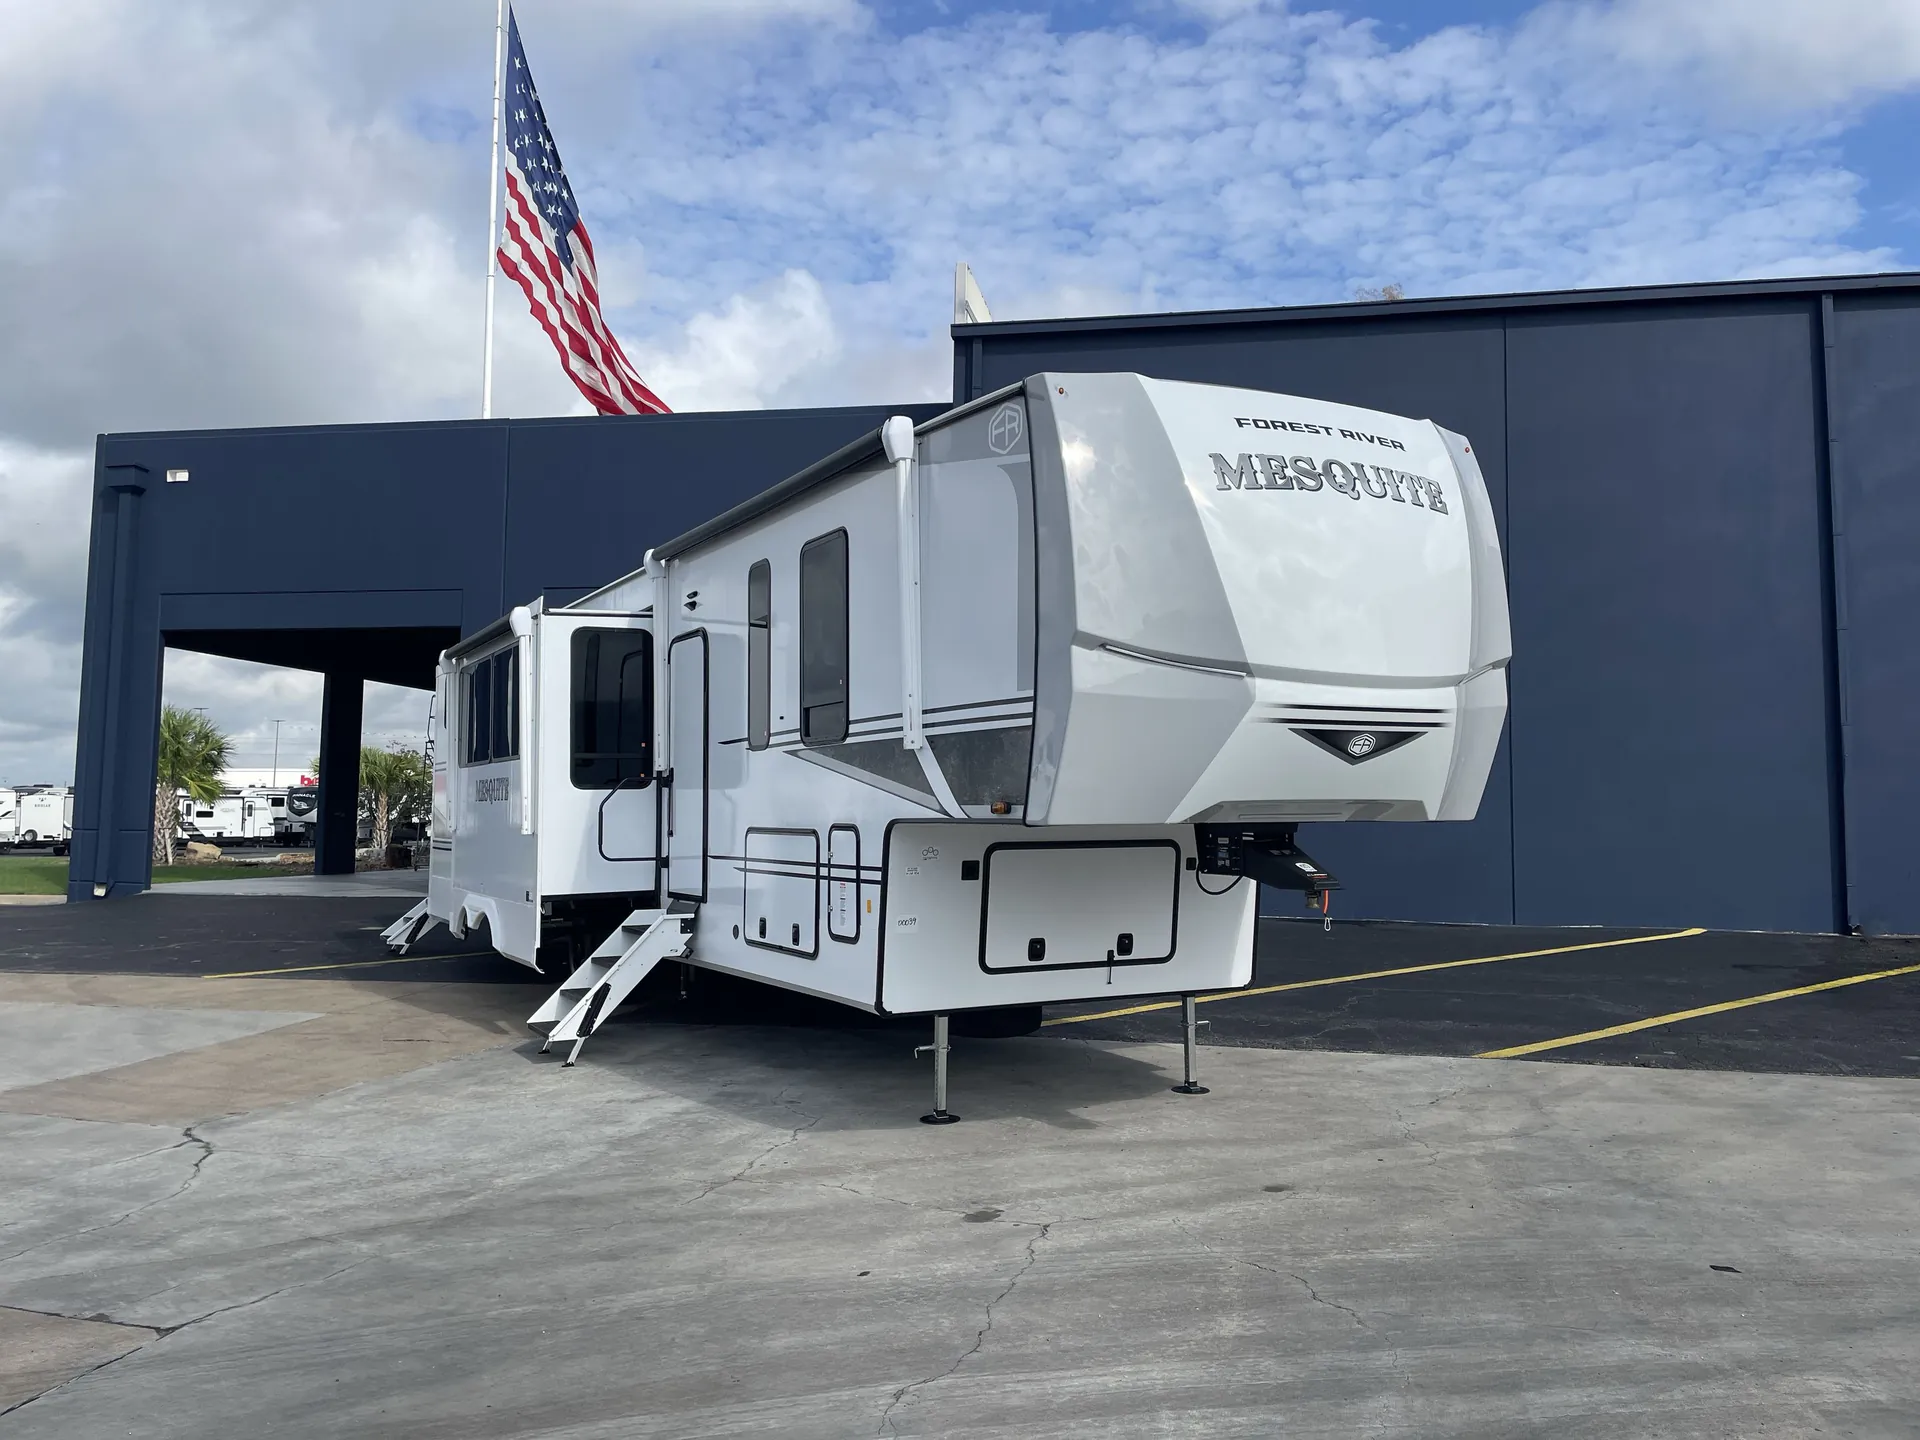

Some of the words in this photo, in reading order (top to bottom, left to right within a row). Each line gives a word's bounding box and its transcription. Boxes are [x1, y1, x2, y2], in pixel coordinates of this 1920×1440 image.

[1234, 417, 1333, 436] FOREST
[1338, 428, 1407, 452] RIVER
[1208, 452, 1449, 516] MESQUITE
[475, 777, 509, 805] MESQUITE
